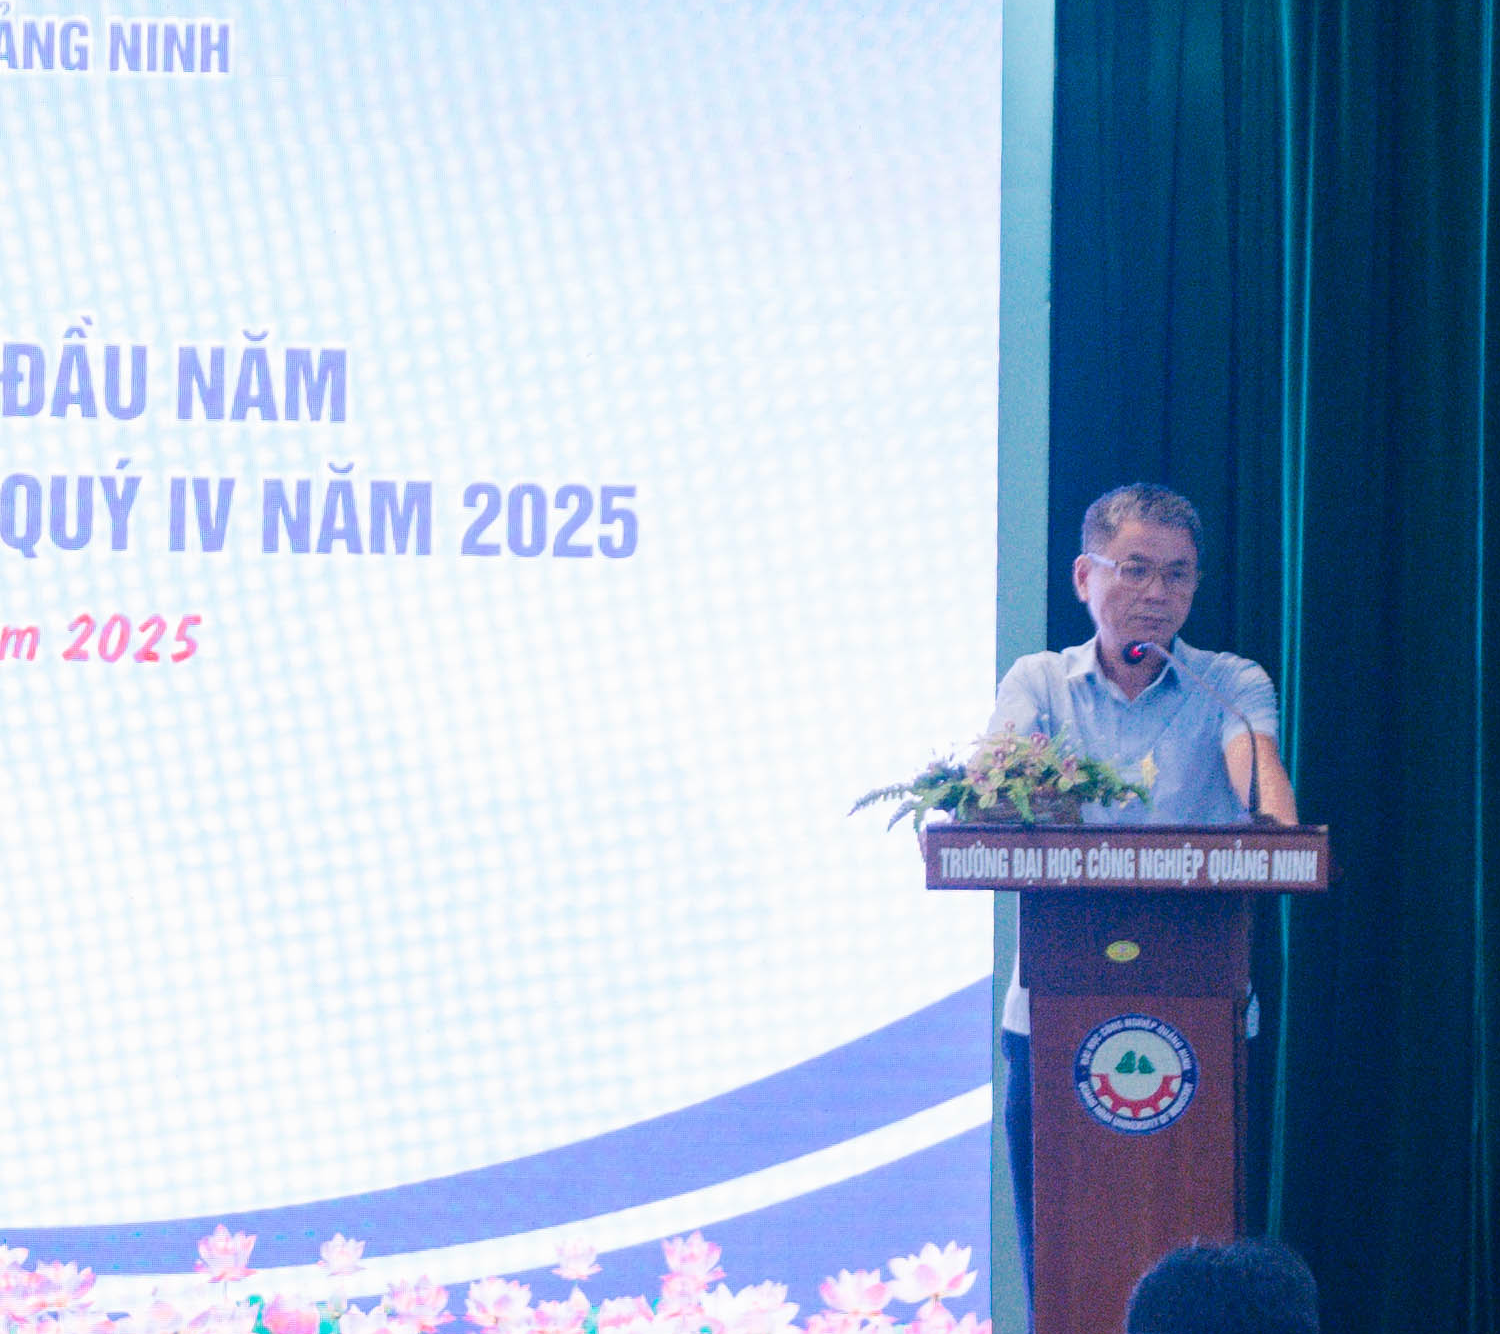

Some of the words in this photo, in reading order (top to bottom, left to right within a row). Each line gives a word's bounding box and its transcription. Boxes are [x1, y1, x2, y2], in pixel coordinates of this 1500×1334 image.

[109, 23, 231, 74] NINH
[0, 316, 148, 421] ĐẦU
[176, 330, 346, 423] NĂM
[0, 459, 141, 559] QUÝ
[168, 479, 236, 553] IV
[261, 462, 432, 556] NĂM
[461, 483, 638, 559] 2025
[62, 613, 201, 665] 2025
[940, 840, 1009, 879] TRƯỜNG
[1012, 848, 1043, 885] ĐẠI
[1047, 848, 1083, 885] HỌC
[1087, 841, 1136, 880] CÔNG
[1139, 842, 1204, 886] NGHIỆP
[1207, 838, 1269, 884] QUẢNG
[1272, 850, 1318, 881] NINH
